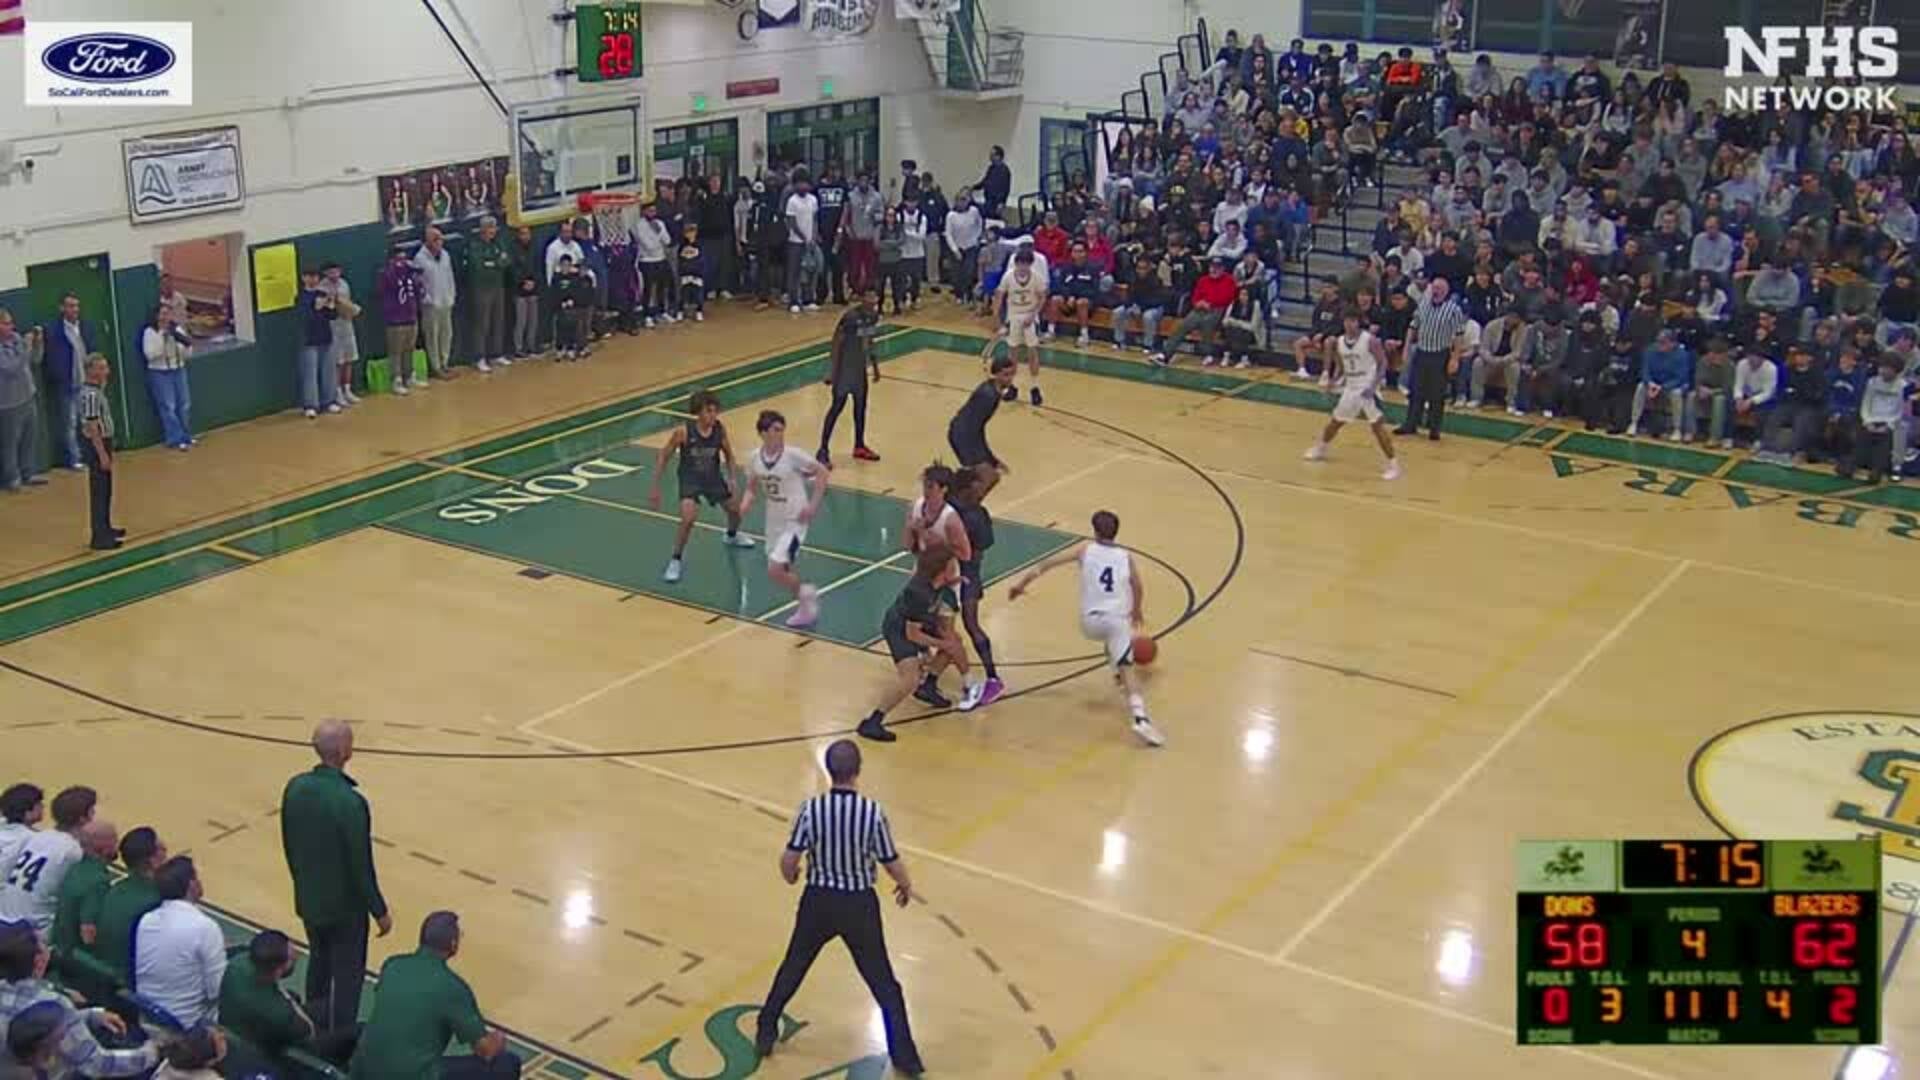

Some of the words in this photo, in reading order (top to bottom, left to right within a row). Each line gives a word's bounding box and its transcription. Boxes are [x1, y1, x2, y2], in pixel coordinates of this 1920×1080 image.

[602, 10, 640, 31] 7:14
[599, 33, 633, 78] 28
[438, 458, 645, 525] DONS
[1099, 566, 1114, 592] 4
[7, 850, 49, 892] 24
